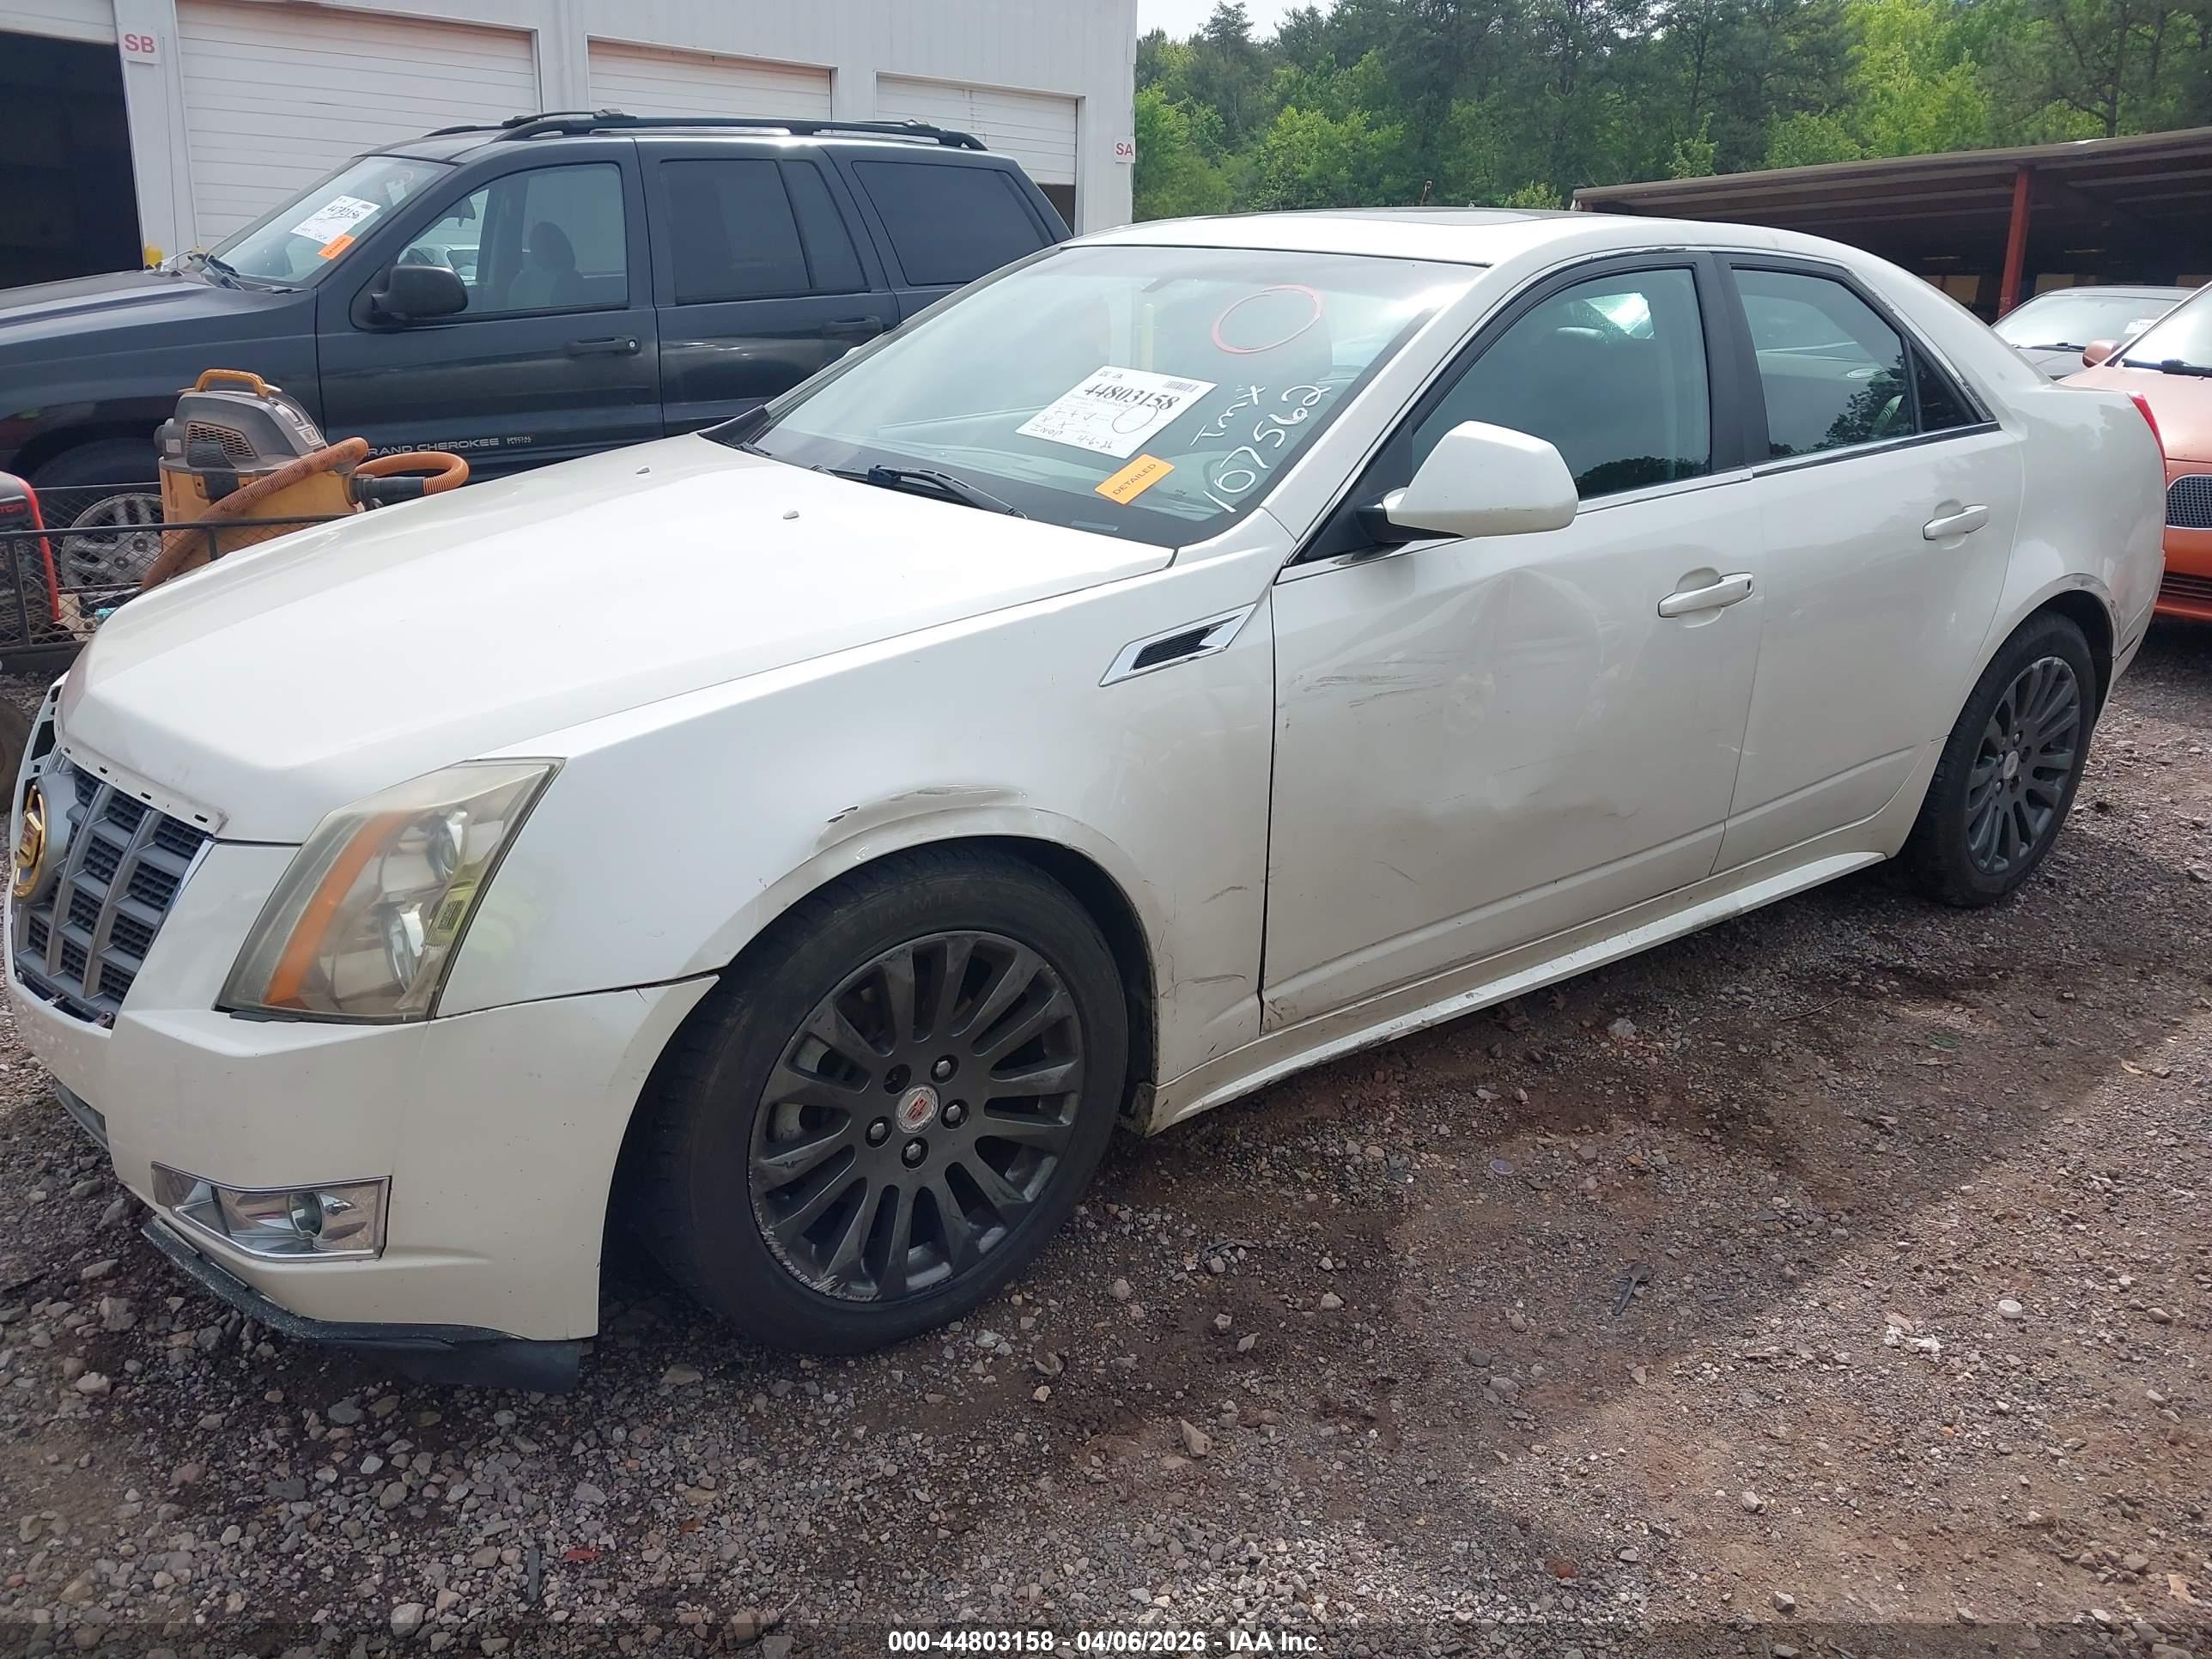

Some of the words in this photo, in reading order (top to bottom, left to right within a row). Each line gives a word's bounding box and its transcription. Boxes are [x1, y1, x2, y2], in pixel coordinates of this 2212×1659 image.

[124, 33, 155, 53] SB
[1115, 143, 1133, 156] SA
[1084, 382, 1181, 410] 44803158
[366, 445, 413, 457] RAND
[416, 437, 500, 453] CHEROKEE
[1202, 385, 1333, 514] 107562
[1112, 463, 1157, 495] DETAILED
